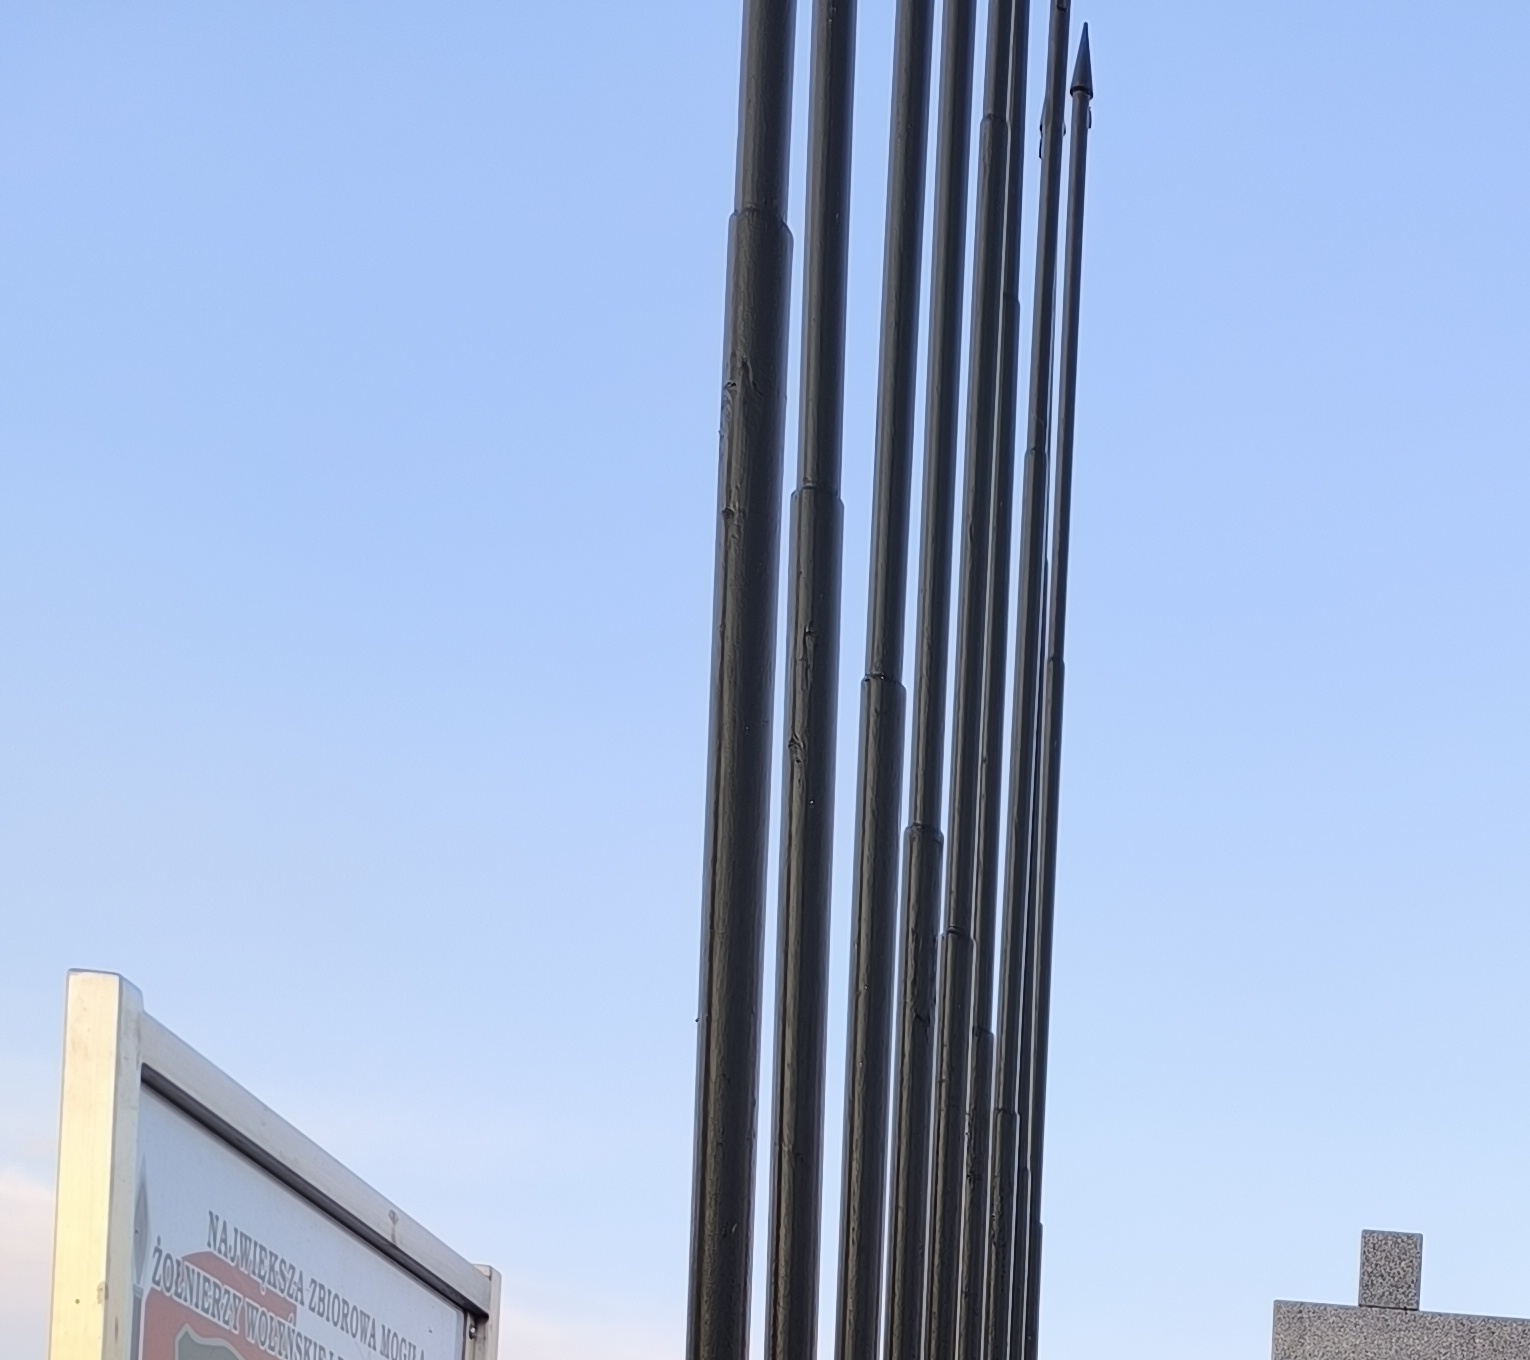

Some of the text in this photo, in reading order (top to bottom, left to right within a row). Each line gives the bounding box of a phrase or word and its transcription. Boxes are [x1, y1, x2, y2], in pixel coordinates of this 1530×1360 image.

[151, 1235, 243, 1332] ŻOŁNIERZY
[206, 1210, 304, 1306] NAJWIĘKSZA
[307, 1278, 377, 1351] ZBIOROWA
